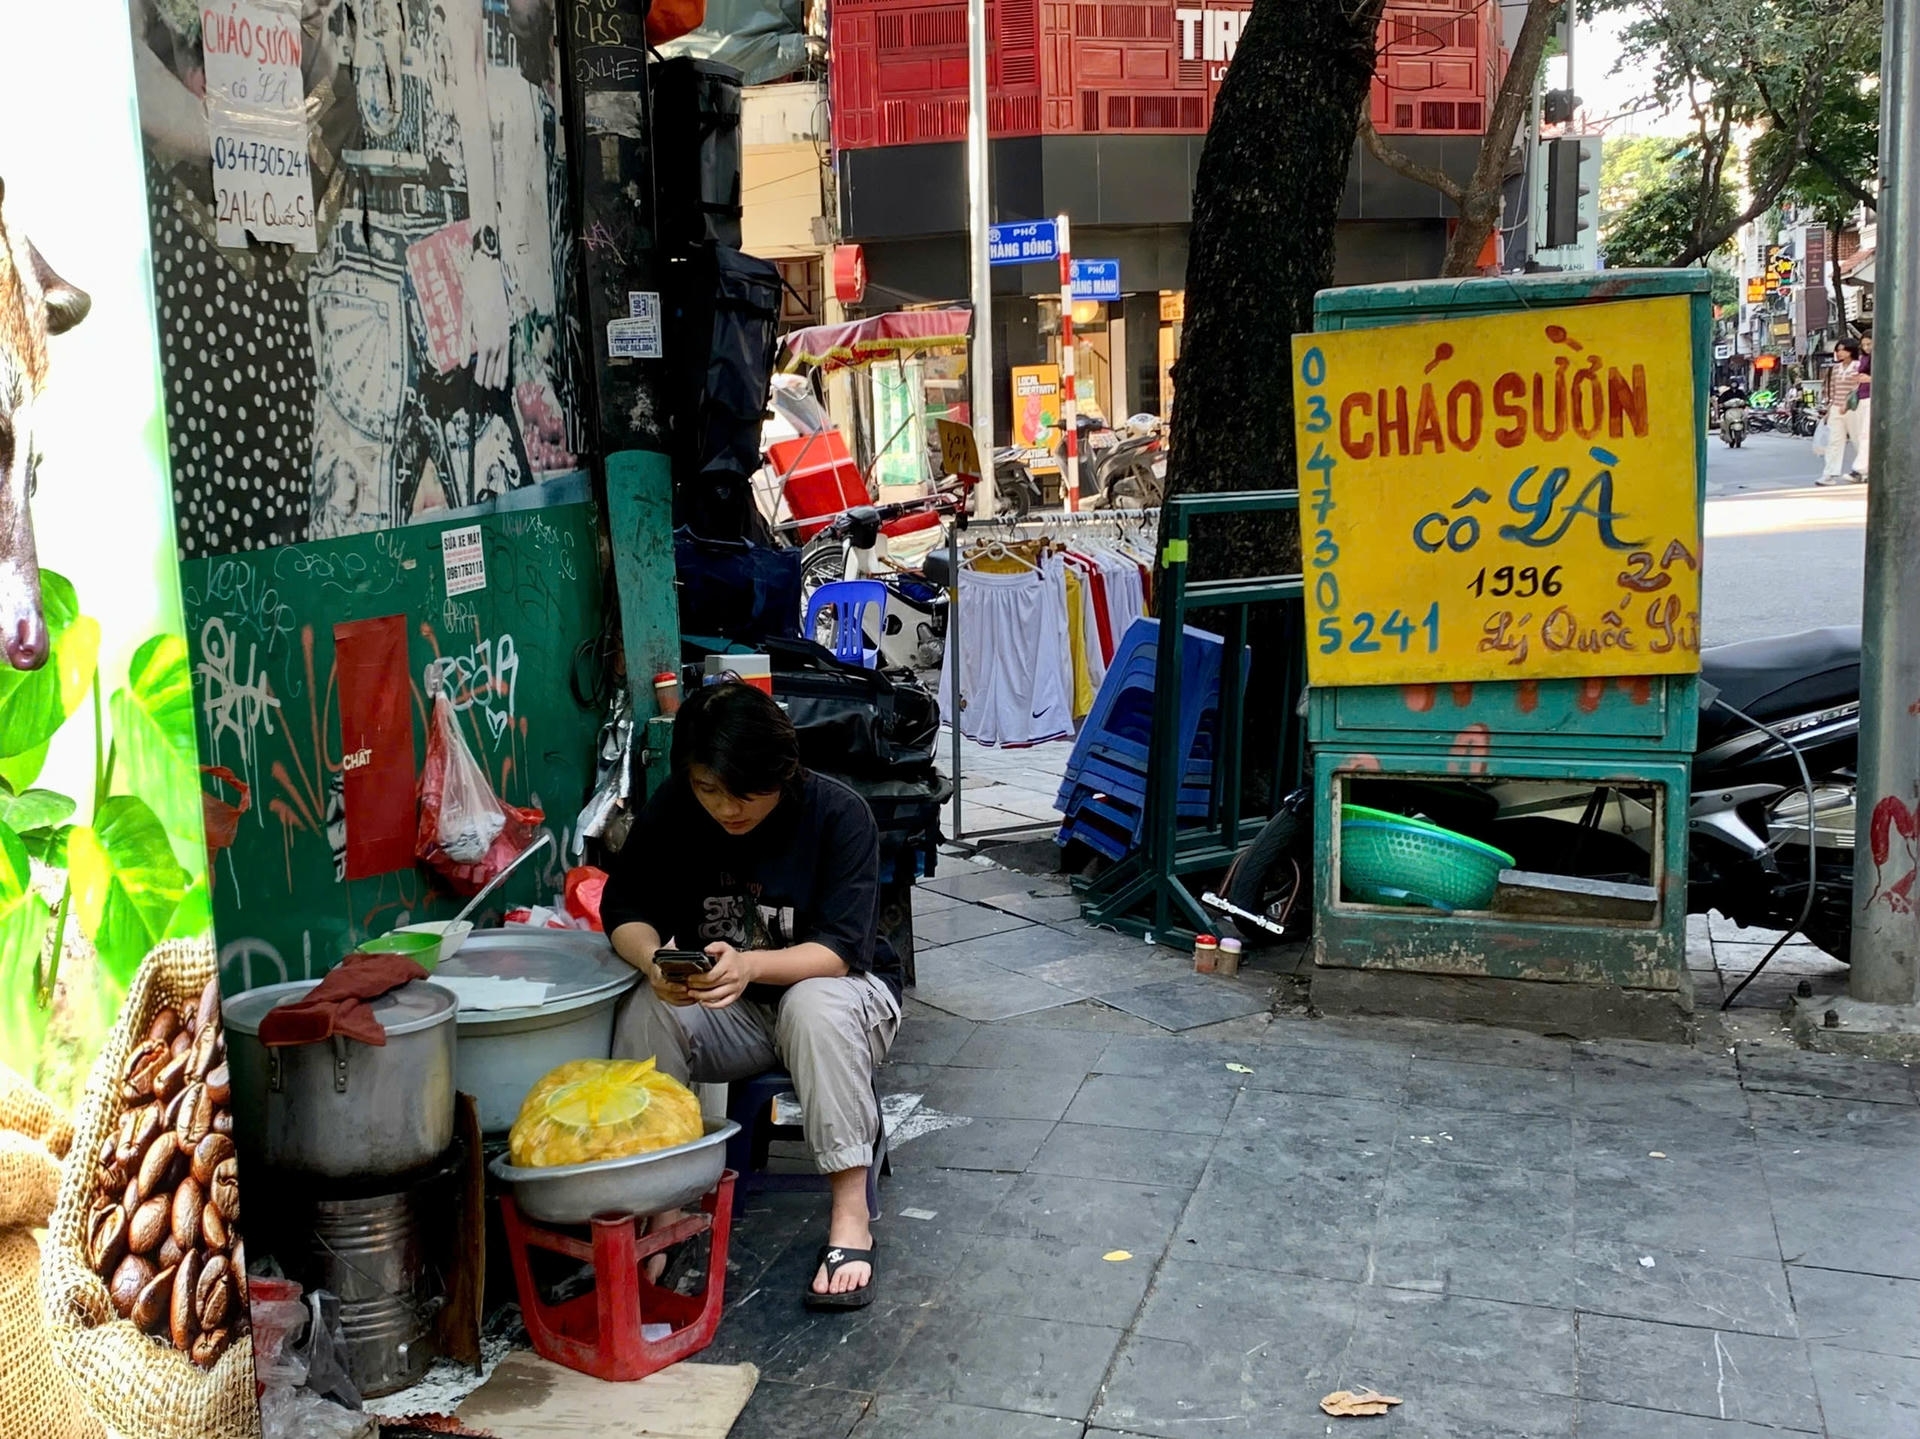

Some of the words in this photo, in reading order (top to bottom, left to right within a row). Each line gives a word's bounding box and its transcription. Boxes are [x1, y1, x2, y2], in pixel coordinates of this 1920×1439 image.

[203, 3, 250, 59] CHÁO
[215, 136, 309, 178] 0347305241
[1013, 224, 1038, 237] PHỐ
[1022, 238, 1052, 256] BÔNG
[1087, 263, 1105, 274] PHỐ
[1339, 342, 1484, 460] CHÁO
[1492, 324, 1649, 449] SƯỜN
[458, 534, 466, 548] XE
[1466, 565, 1563, 598] 1996
[1617, 538, 1697, 592] 2A
